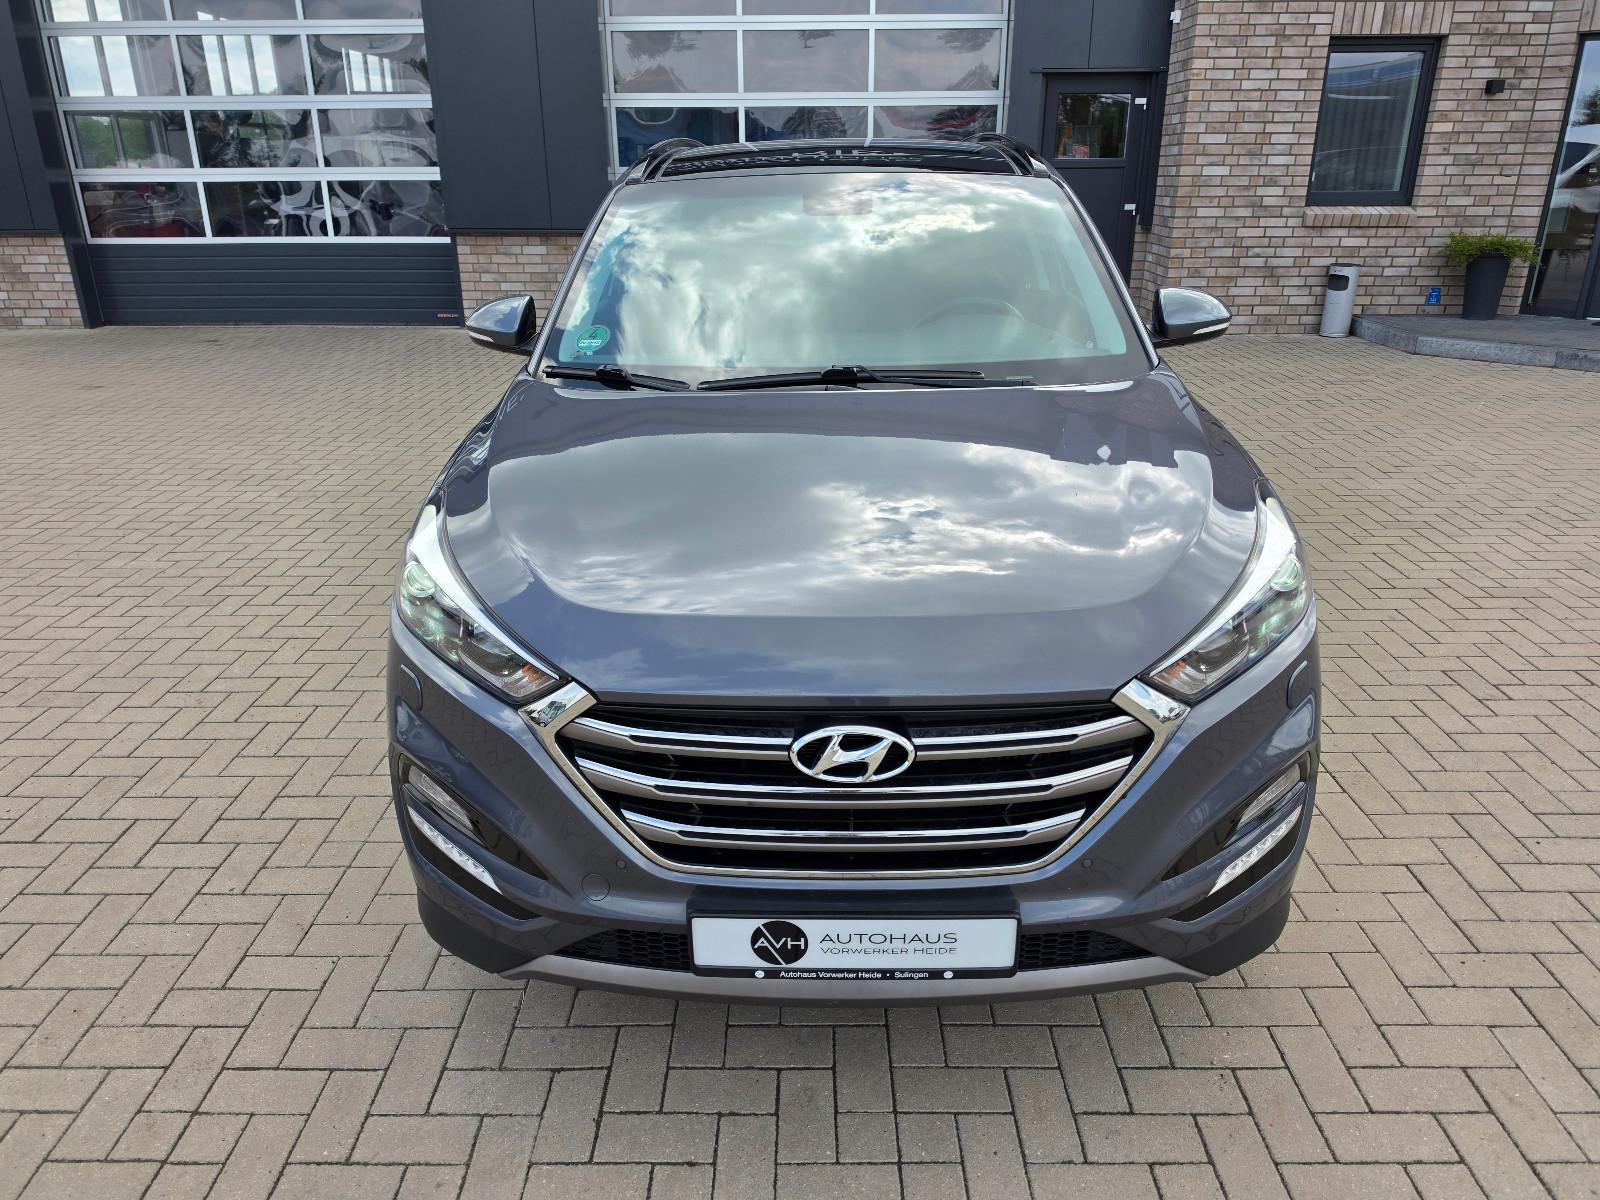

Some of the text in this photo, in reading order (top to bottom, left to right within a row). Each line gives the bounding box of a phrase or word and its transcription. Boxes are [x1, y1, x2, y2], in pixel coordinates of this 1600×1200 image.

[753, 937, 805, 950] AVH
[819, 933, 958, 945] AUTOHAUS
[819, 947, 957, 955] VORWERKER HEIDE
[779, 970, 929, 980] Autohaus Vorwerker Heide Sulingen
